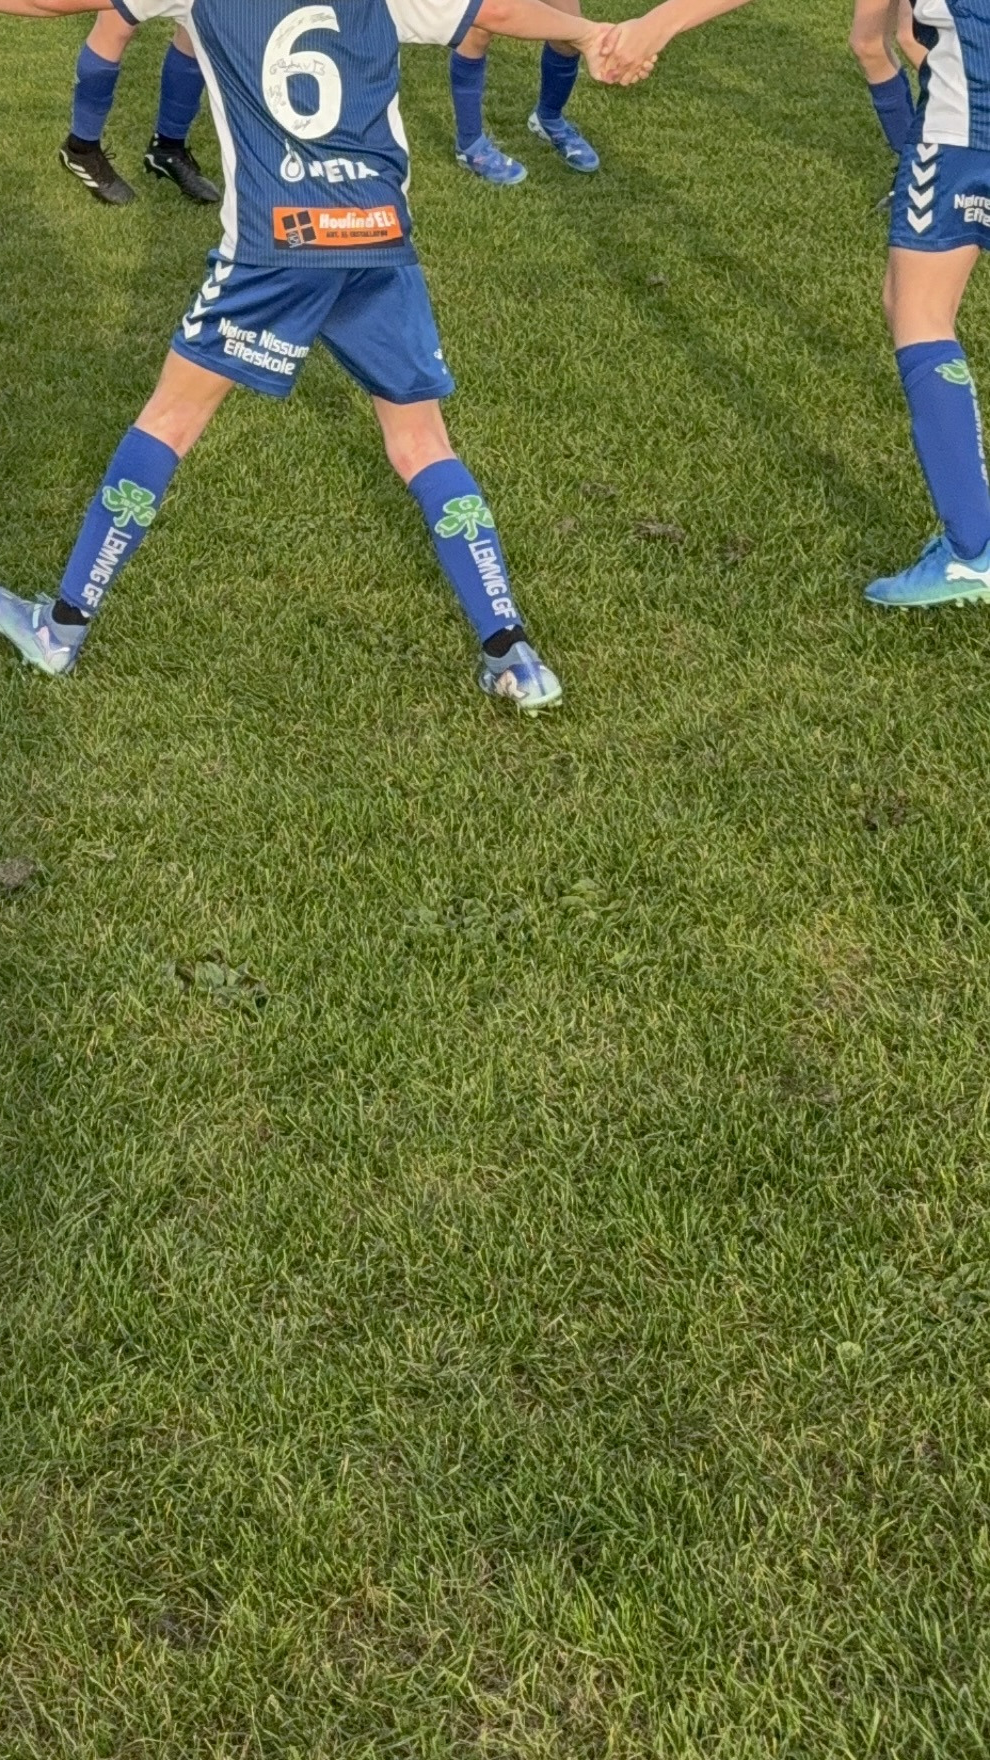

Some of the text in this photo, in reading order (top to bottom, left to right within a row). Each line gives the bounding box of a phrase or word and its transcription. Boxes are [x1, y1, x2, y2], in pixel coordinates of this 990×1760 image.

[262, 5, 342, 140] 6
[217, 317, 310, 358] Nørre Nissum
[223, 338, 296, 376] Efterskole
[89, 526, 132, 585] LEMVIG
[468, 539, 508, 597] LEMVIG
[491, 597, 517, 619] GF
[80, 582, 104, 608] GF
